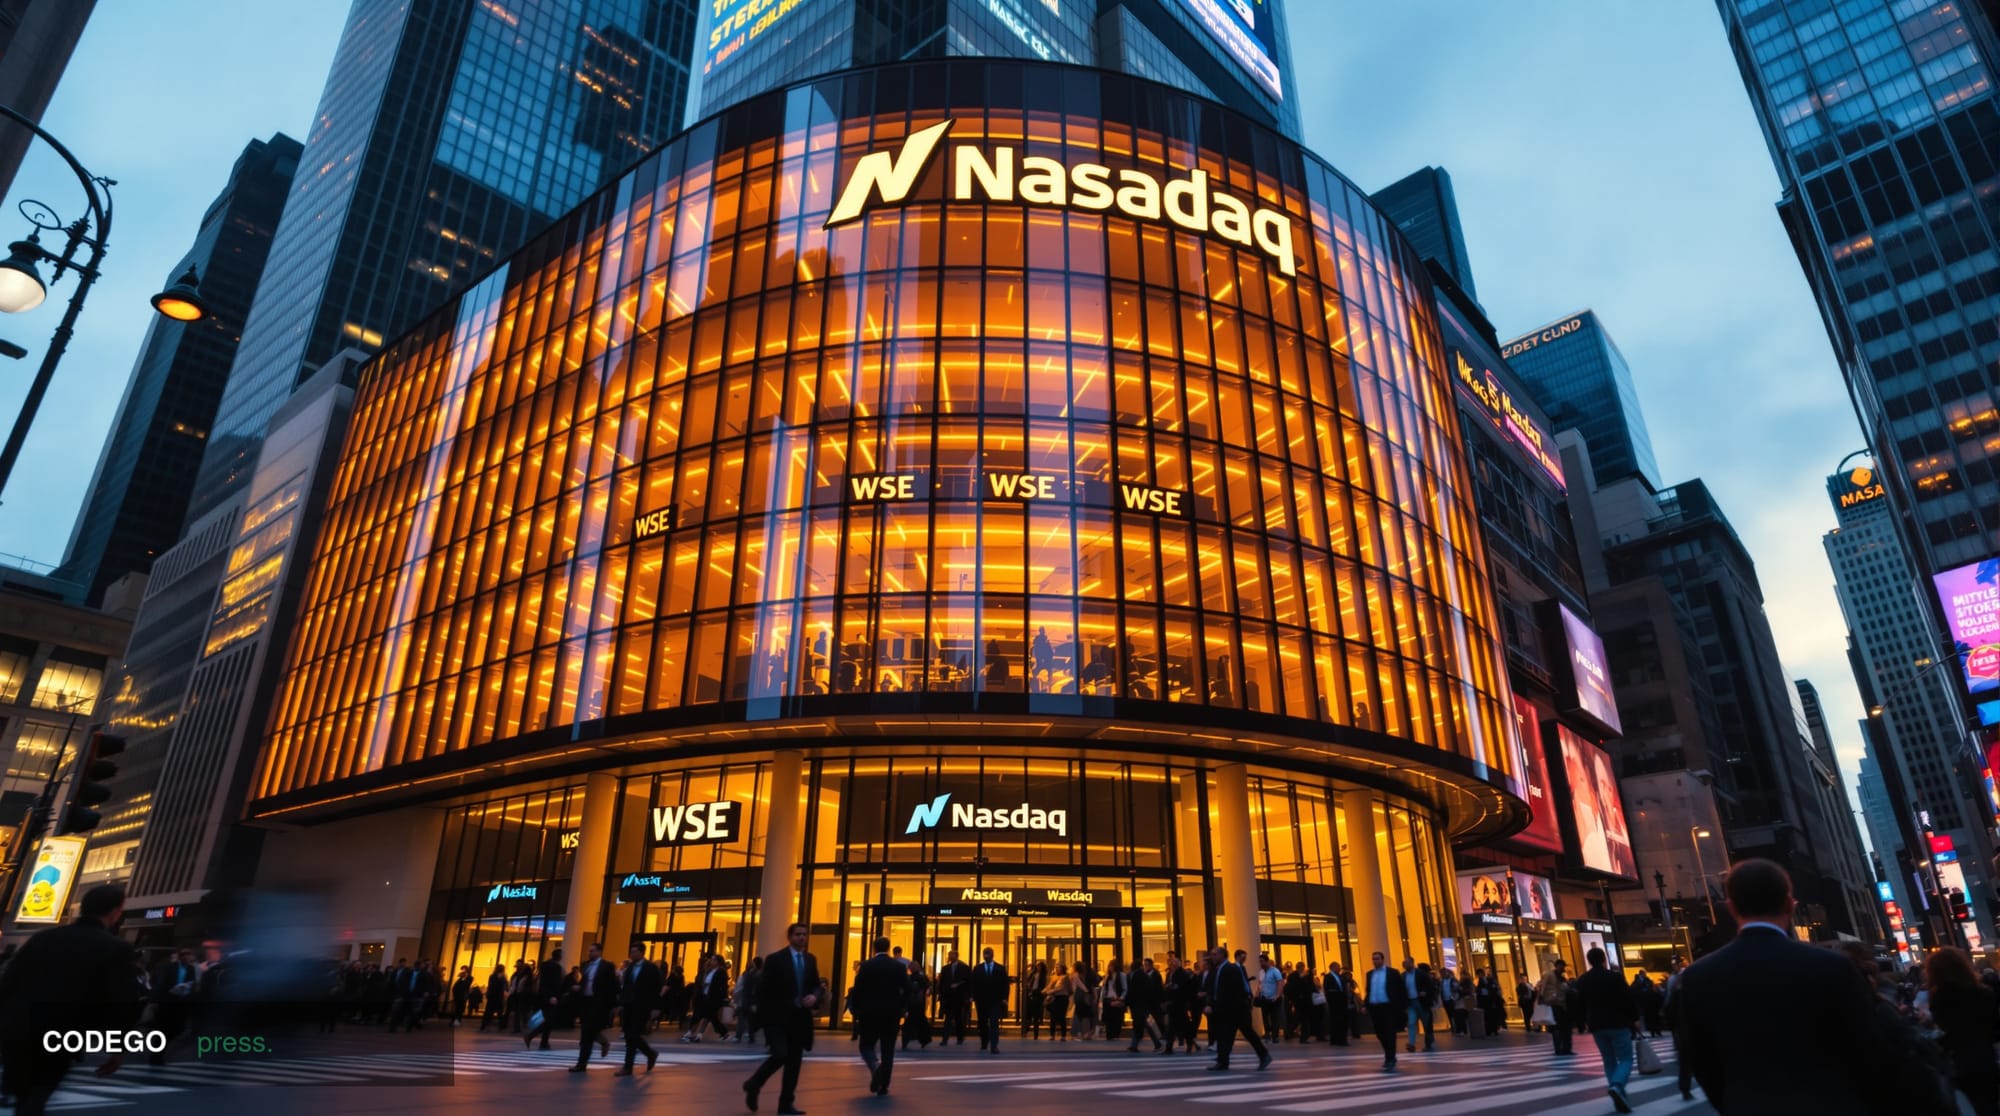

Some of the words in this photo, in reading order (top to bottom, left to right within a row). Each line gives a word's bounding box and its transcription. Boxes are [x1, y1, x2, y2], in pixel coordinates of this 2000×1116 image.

[954, 145, 1296, 277] Nasadaq
[851, 474, 915, 501] WSE
[989, 473, 1056, 500] WSE
[1121, 484, 1183, 516] WSE
[635, 509, 670, 538] WSE
[653, 800, 732, 841] WSE
[951, 803, 1067, 837] Nasdaq
[961, 888, 1013, 903] Nasdaq
[1047, 889, 1093, 904] Wasdaq
